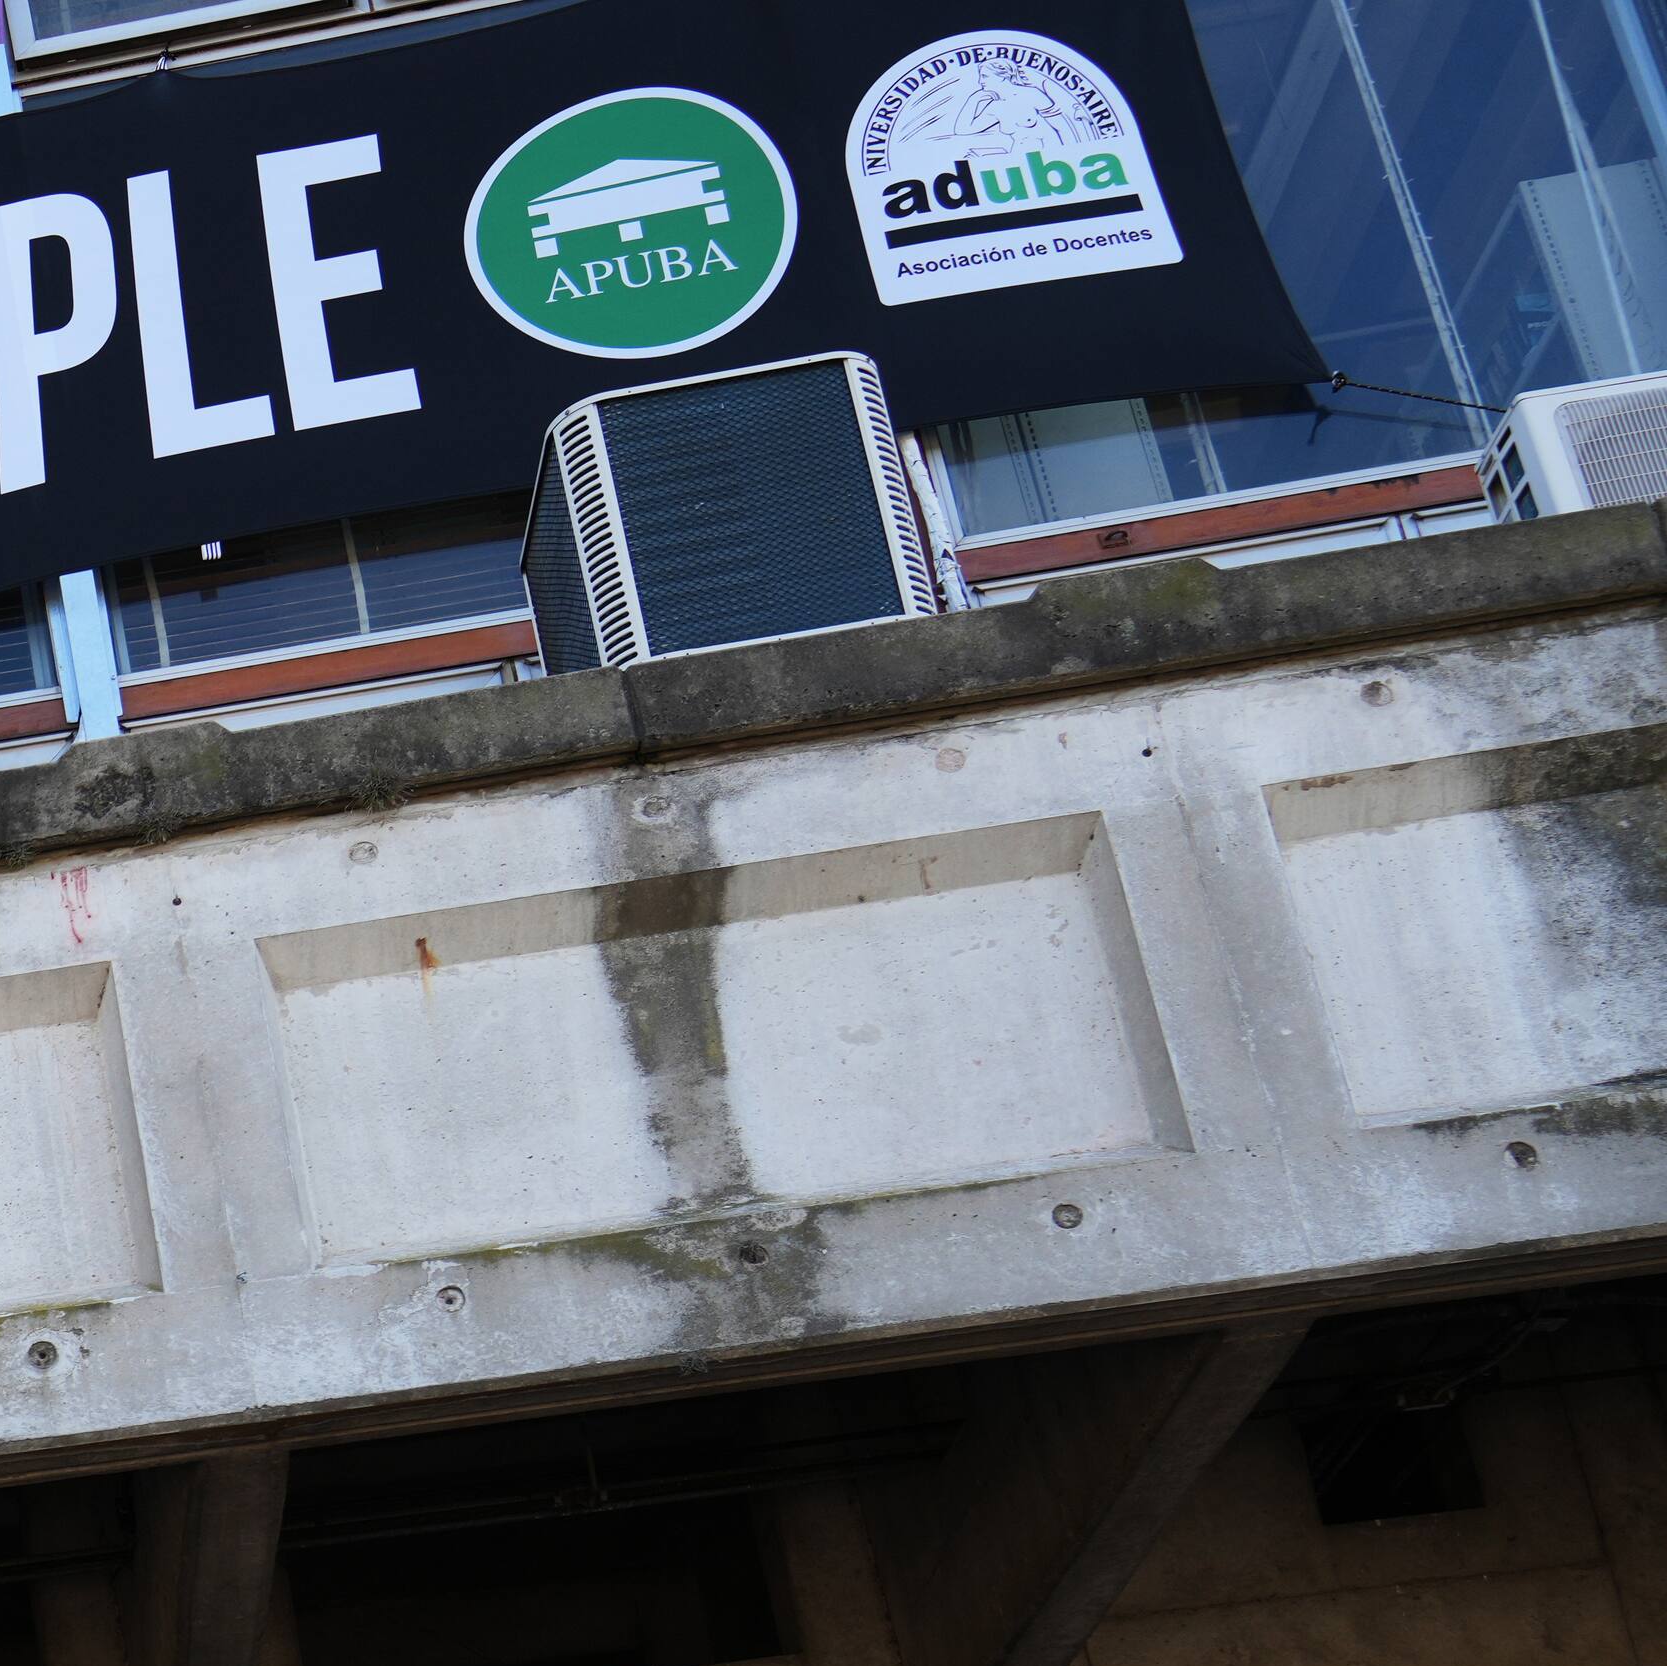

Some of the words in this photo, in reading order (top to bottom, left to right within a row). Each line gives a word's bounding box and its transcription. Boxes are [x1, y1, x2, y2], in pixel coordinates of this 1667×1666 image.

[865, 58, 948, 176] NIVERSIDAD
[881, 150, 1130, 219] aduba
[545, 239, 739, 304] APUBA
[897, 247, 1016, 278] Asociación
[1022, 240, 1048, 258] de
[1053, 227, 1153, 253] Docentes
